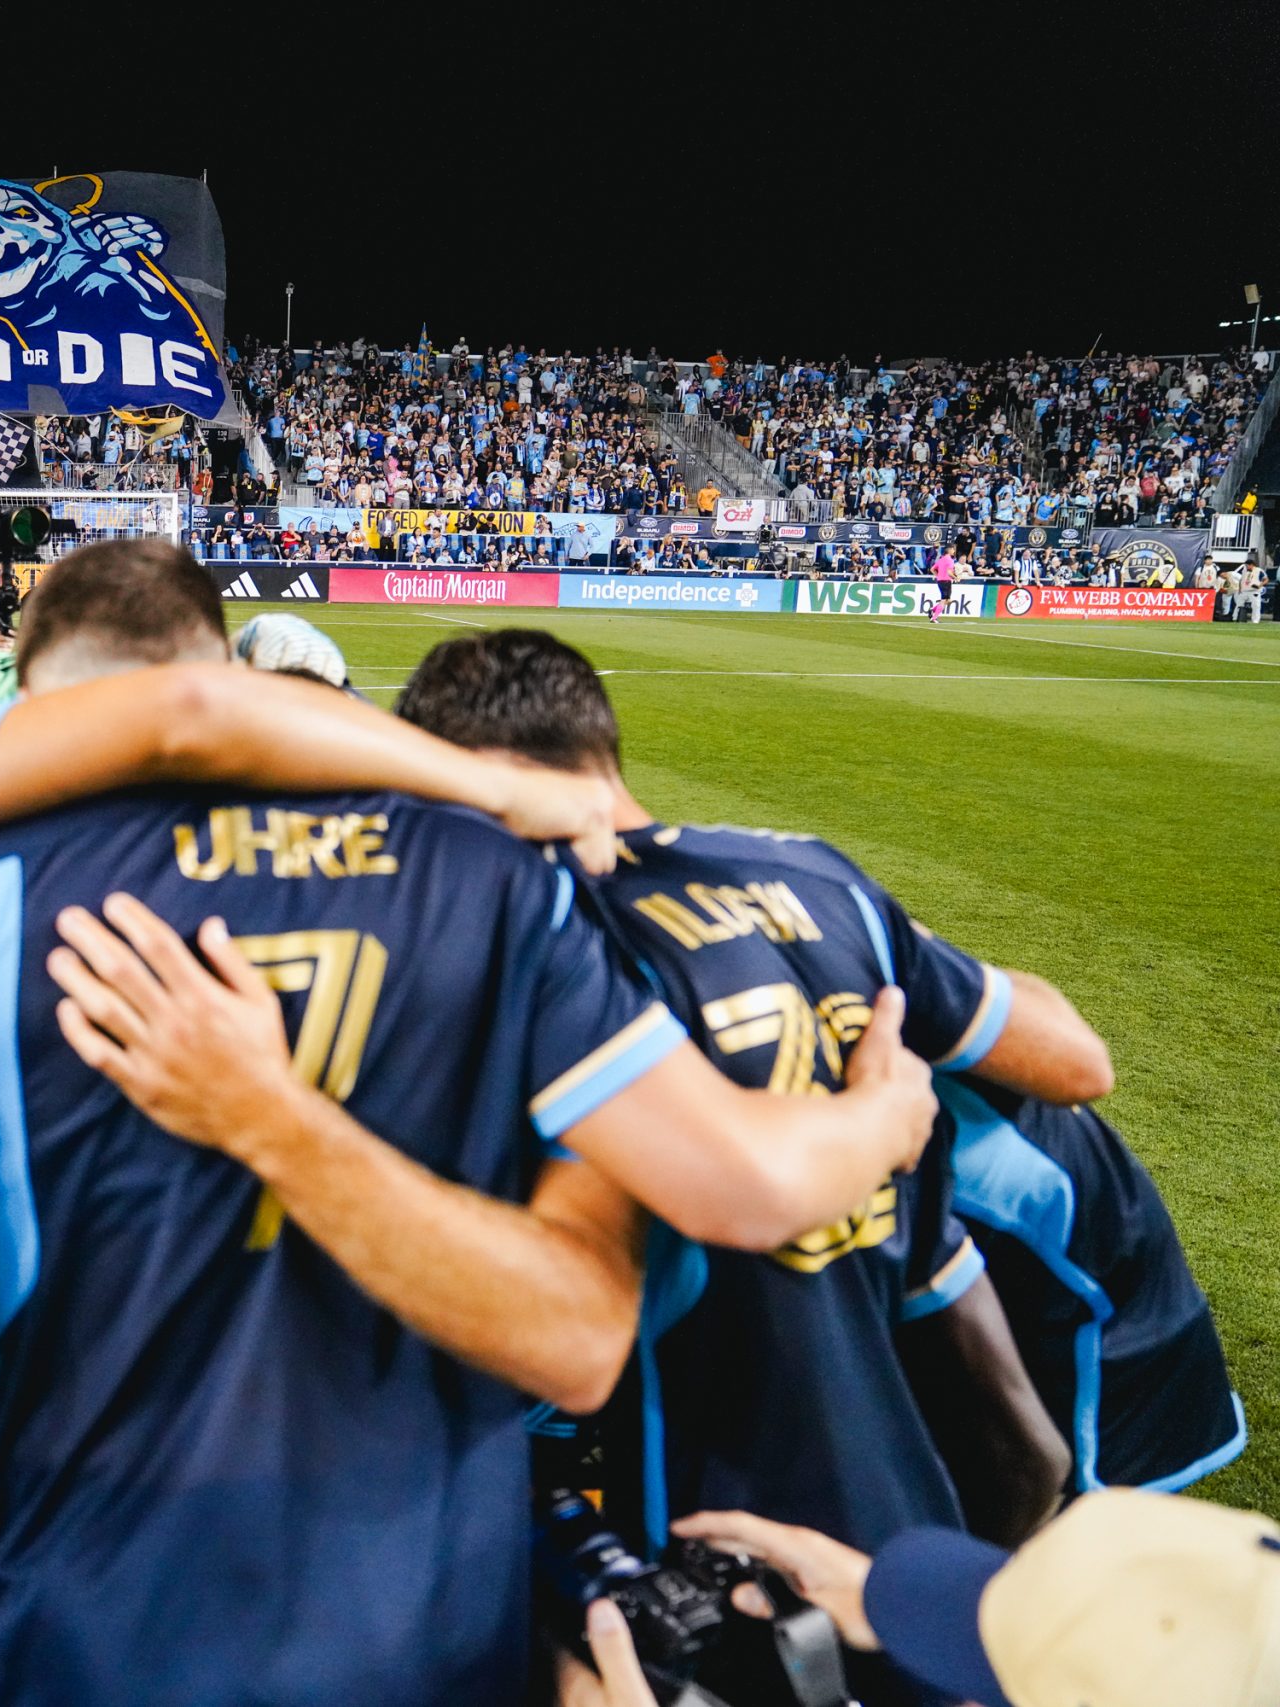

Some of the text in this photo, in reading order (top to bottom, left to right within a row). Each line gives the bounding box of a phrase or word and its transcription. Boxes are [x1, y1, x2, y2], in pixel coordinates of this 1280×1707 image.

[22, 349, 49, 366] OR
[57, 331, 213, 397] DIE
[383, 572, 506, 604] Captain Morgan
[582, 579, 731, 605] Independence
[808, 581, 916, 615] WSFS
[1039, 590, 1209, 607] F.W. WEBB COMPANY
[173, 806, 400, 882] UHRE
